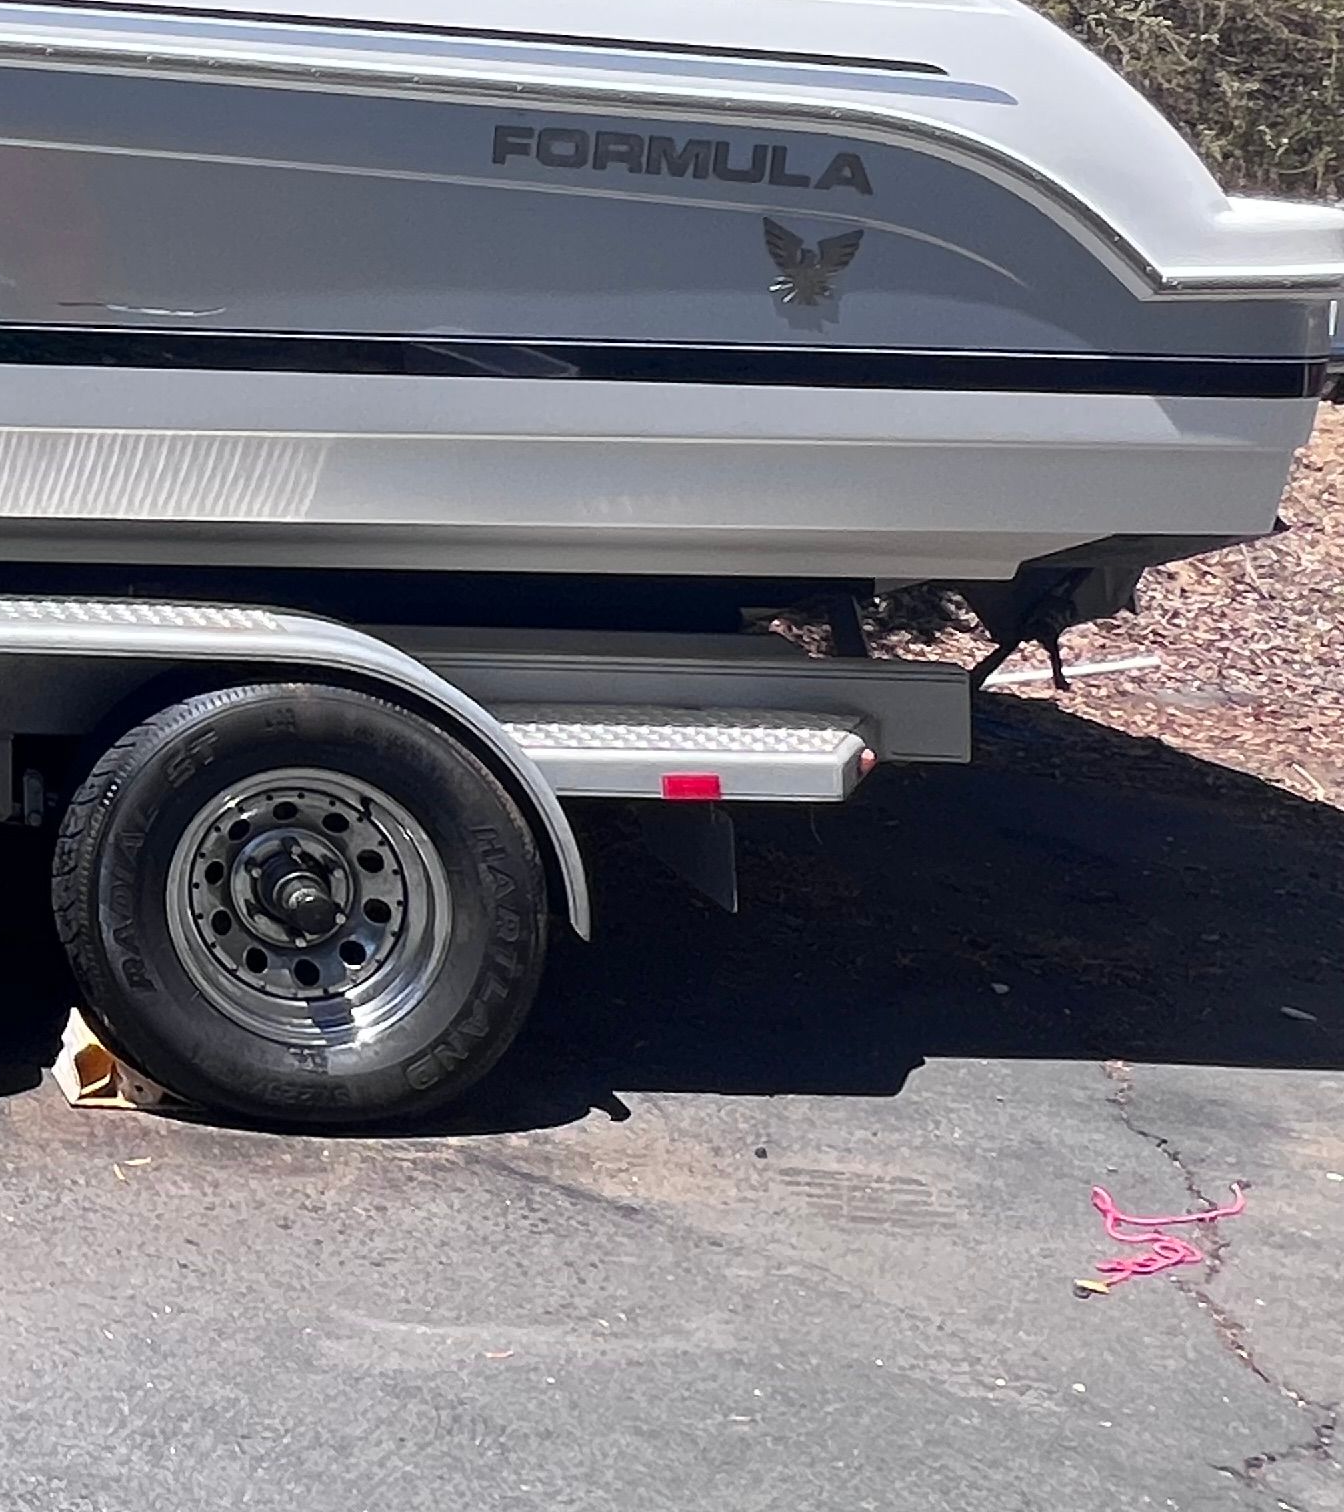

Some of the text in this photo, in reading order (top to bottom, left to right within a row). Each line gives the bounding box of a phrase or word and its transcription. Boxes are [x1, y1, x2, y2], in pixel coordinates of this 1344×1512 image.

[492, 124, 874, 195] FORMULA
[110, 727, 220, 992] RADIAL ST
[403, 823, 521, 1092] HARTLAND
